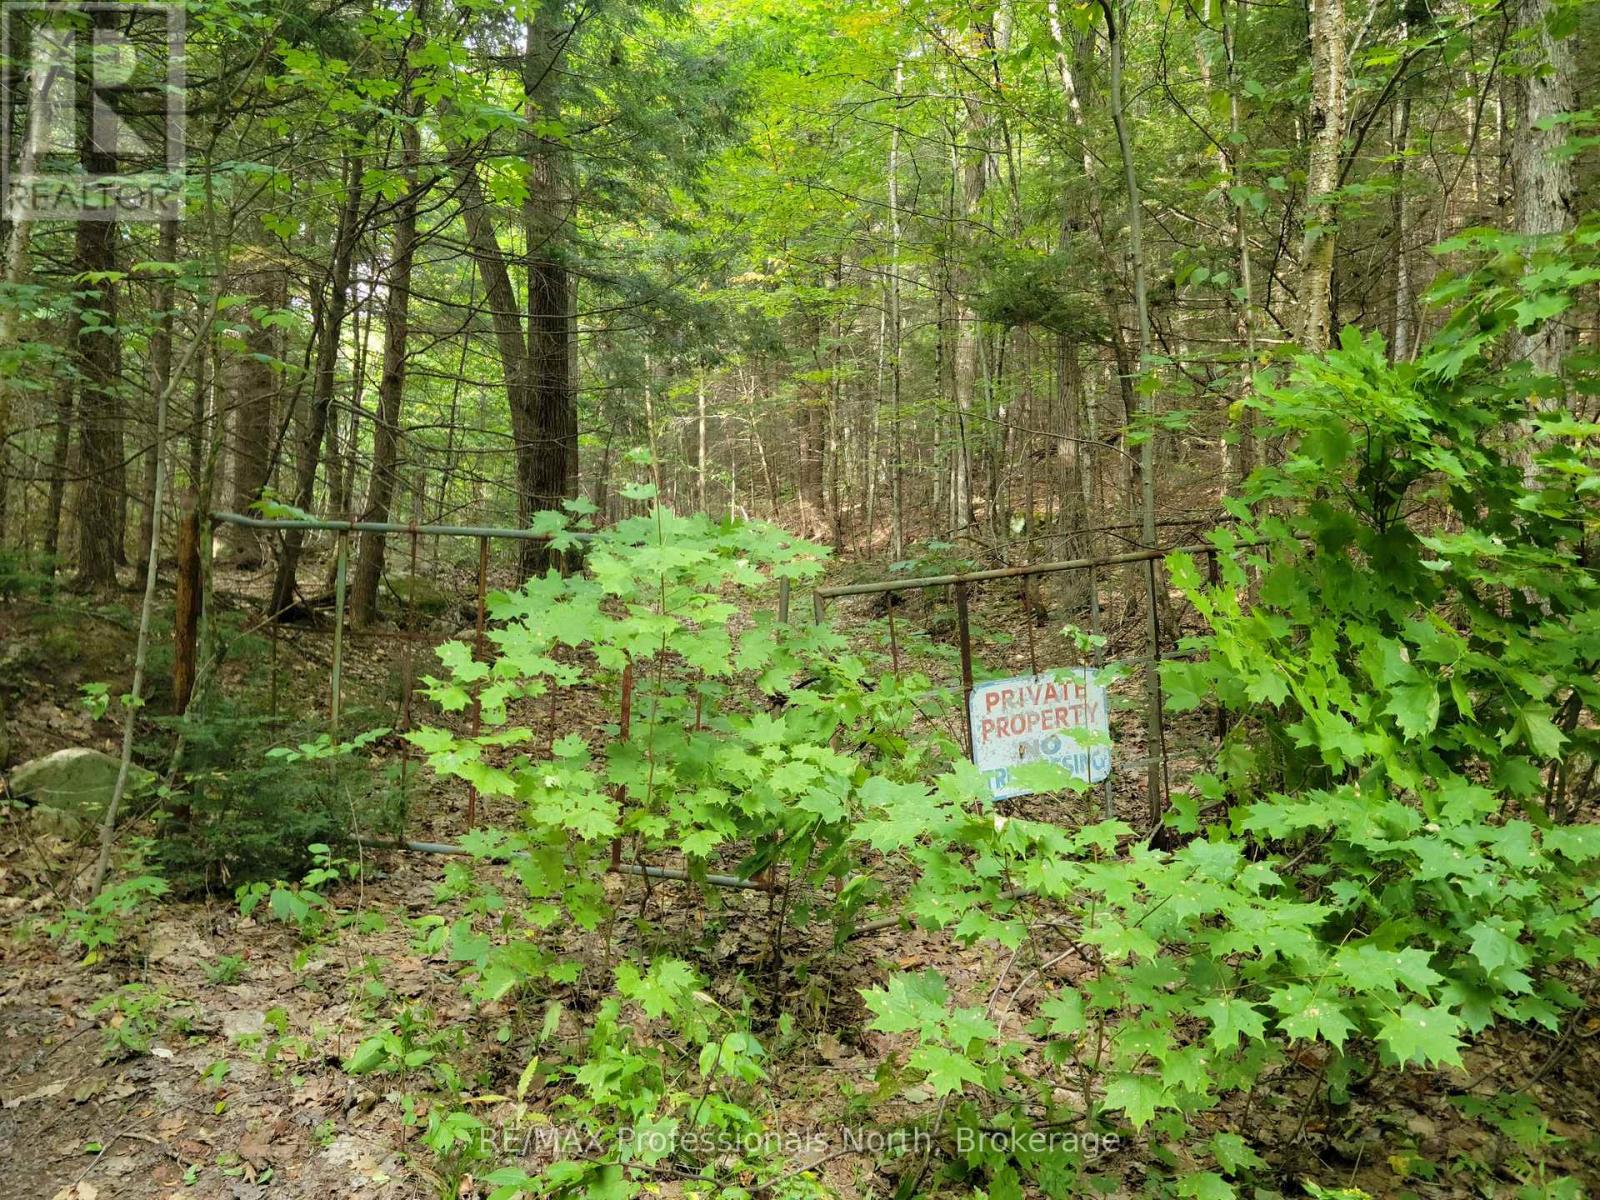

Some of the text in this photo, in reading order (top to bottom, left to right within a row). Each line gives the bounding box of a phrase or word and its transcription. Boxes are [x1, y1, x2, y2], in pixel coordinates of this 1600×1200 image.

[985, 680, 1086, 714] PRIVATE
[981, 702, 1098, 743] PROPERTY
[1017, 734, 1062, 760] NO
